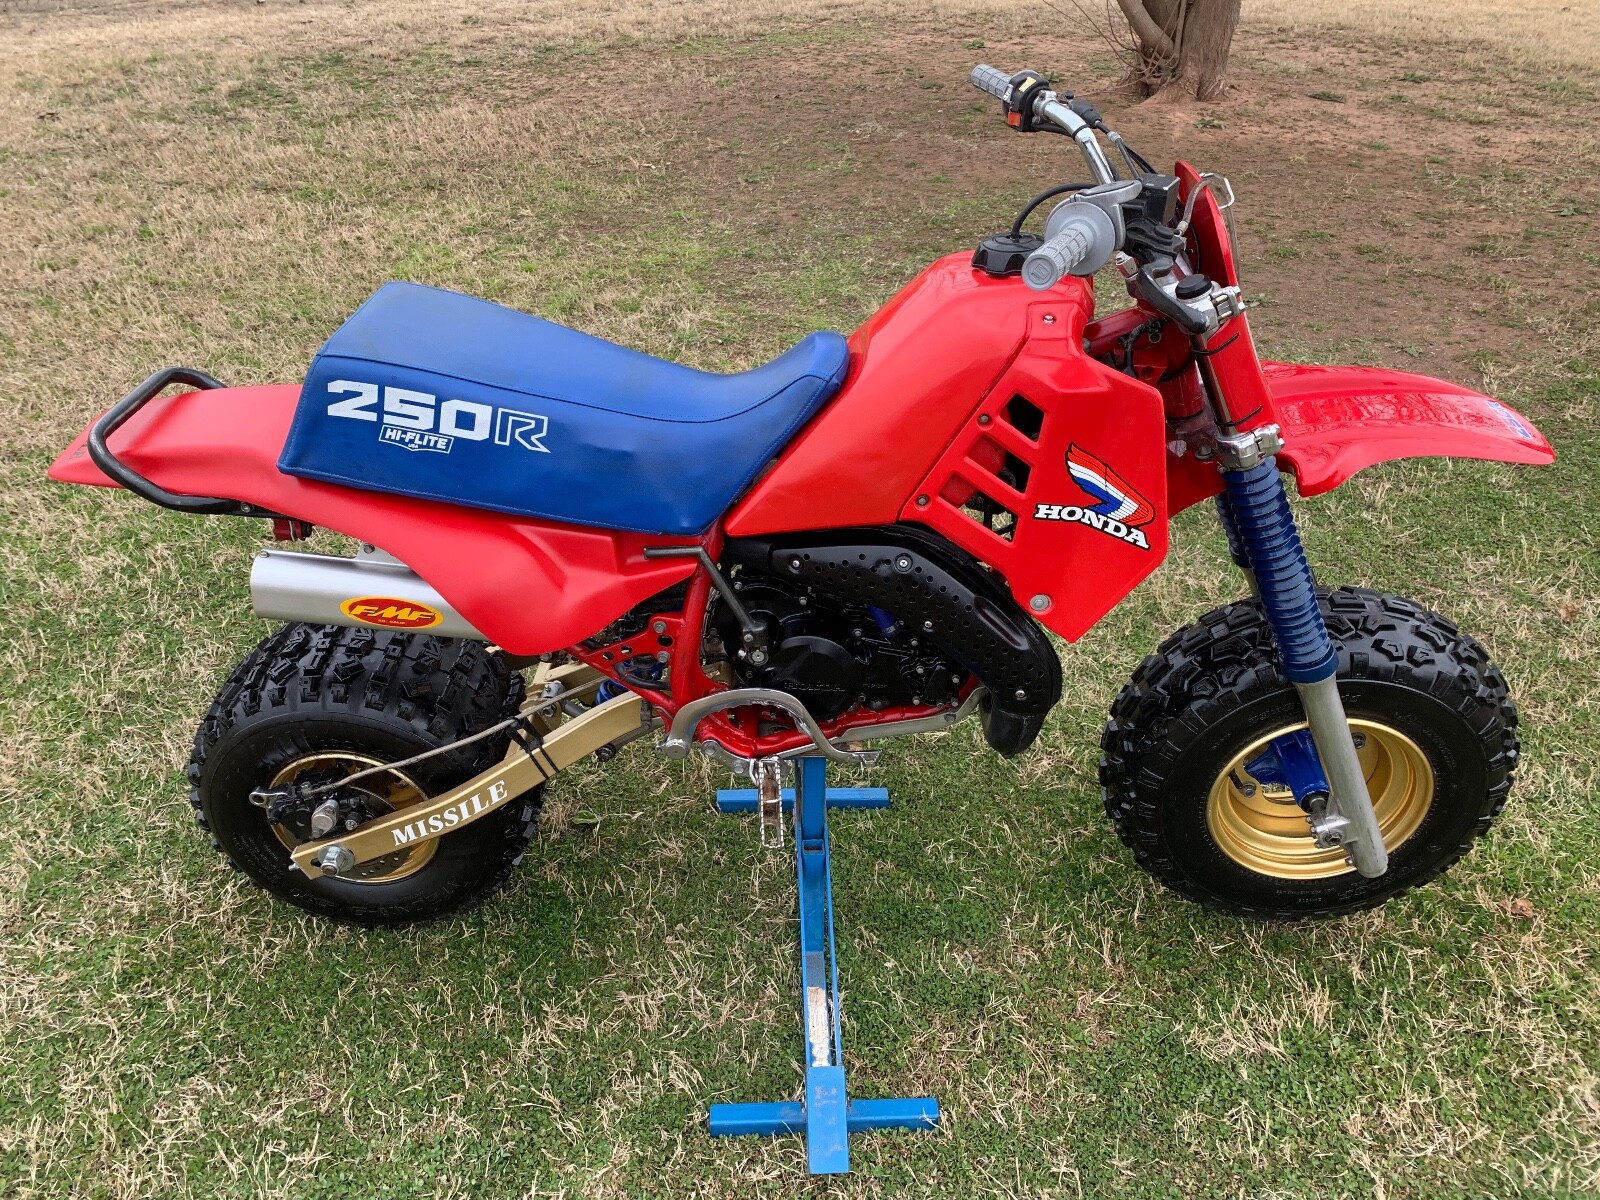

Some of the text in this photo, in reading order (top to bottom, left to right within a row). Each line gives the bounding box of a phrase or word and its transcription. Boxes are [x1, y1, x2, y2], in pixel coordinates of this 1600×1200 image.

[327, 380, 551, 453] 250R
[384, 428, 449, 450] HI-FLITE
[1034, 504, 1149, 549] HONDA
[349, 604, 437, 621] FMF
[390, 779, 508, 847] MISSILE
